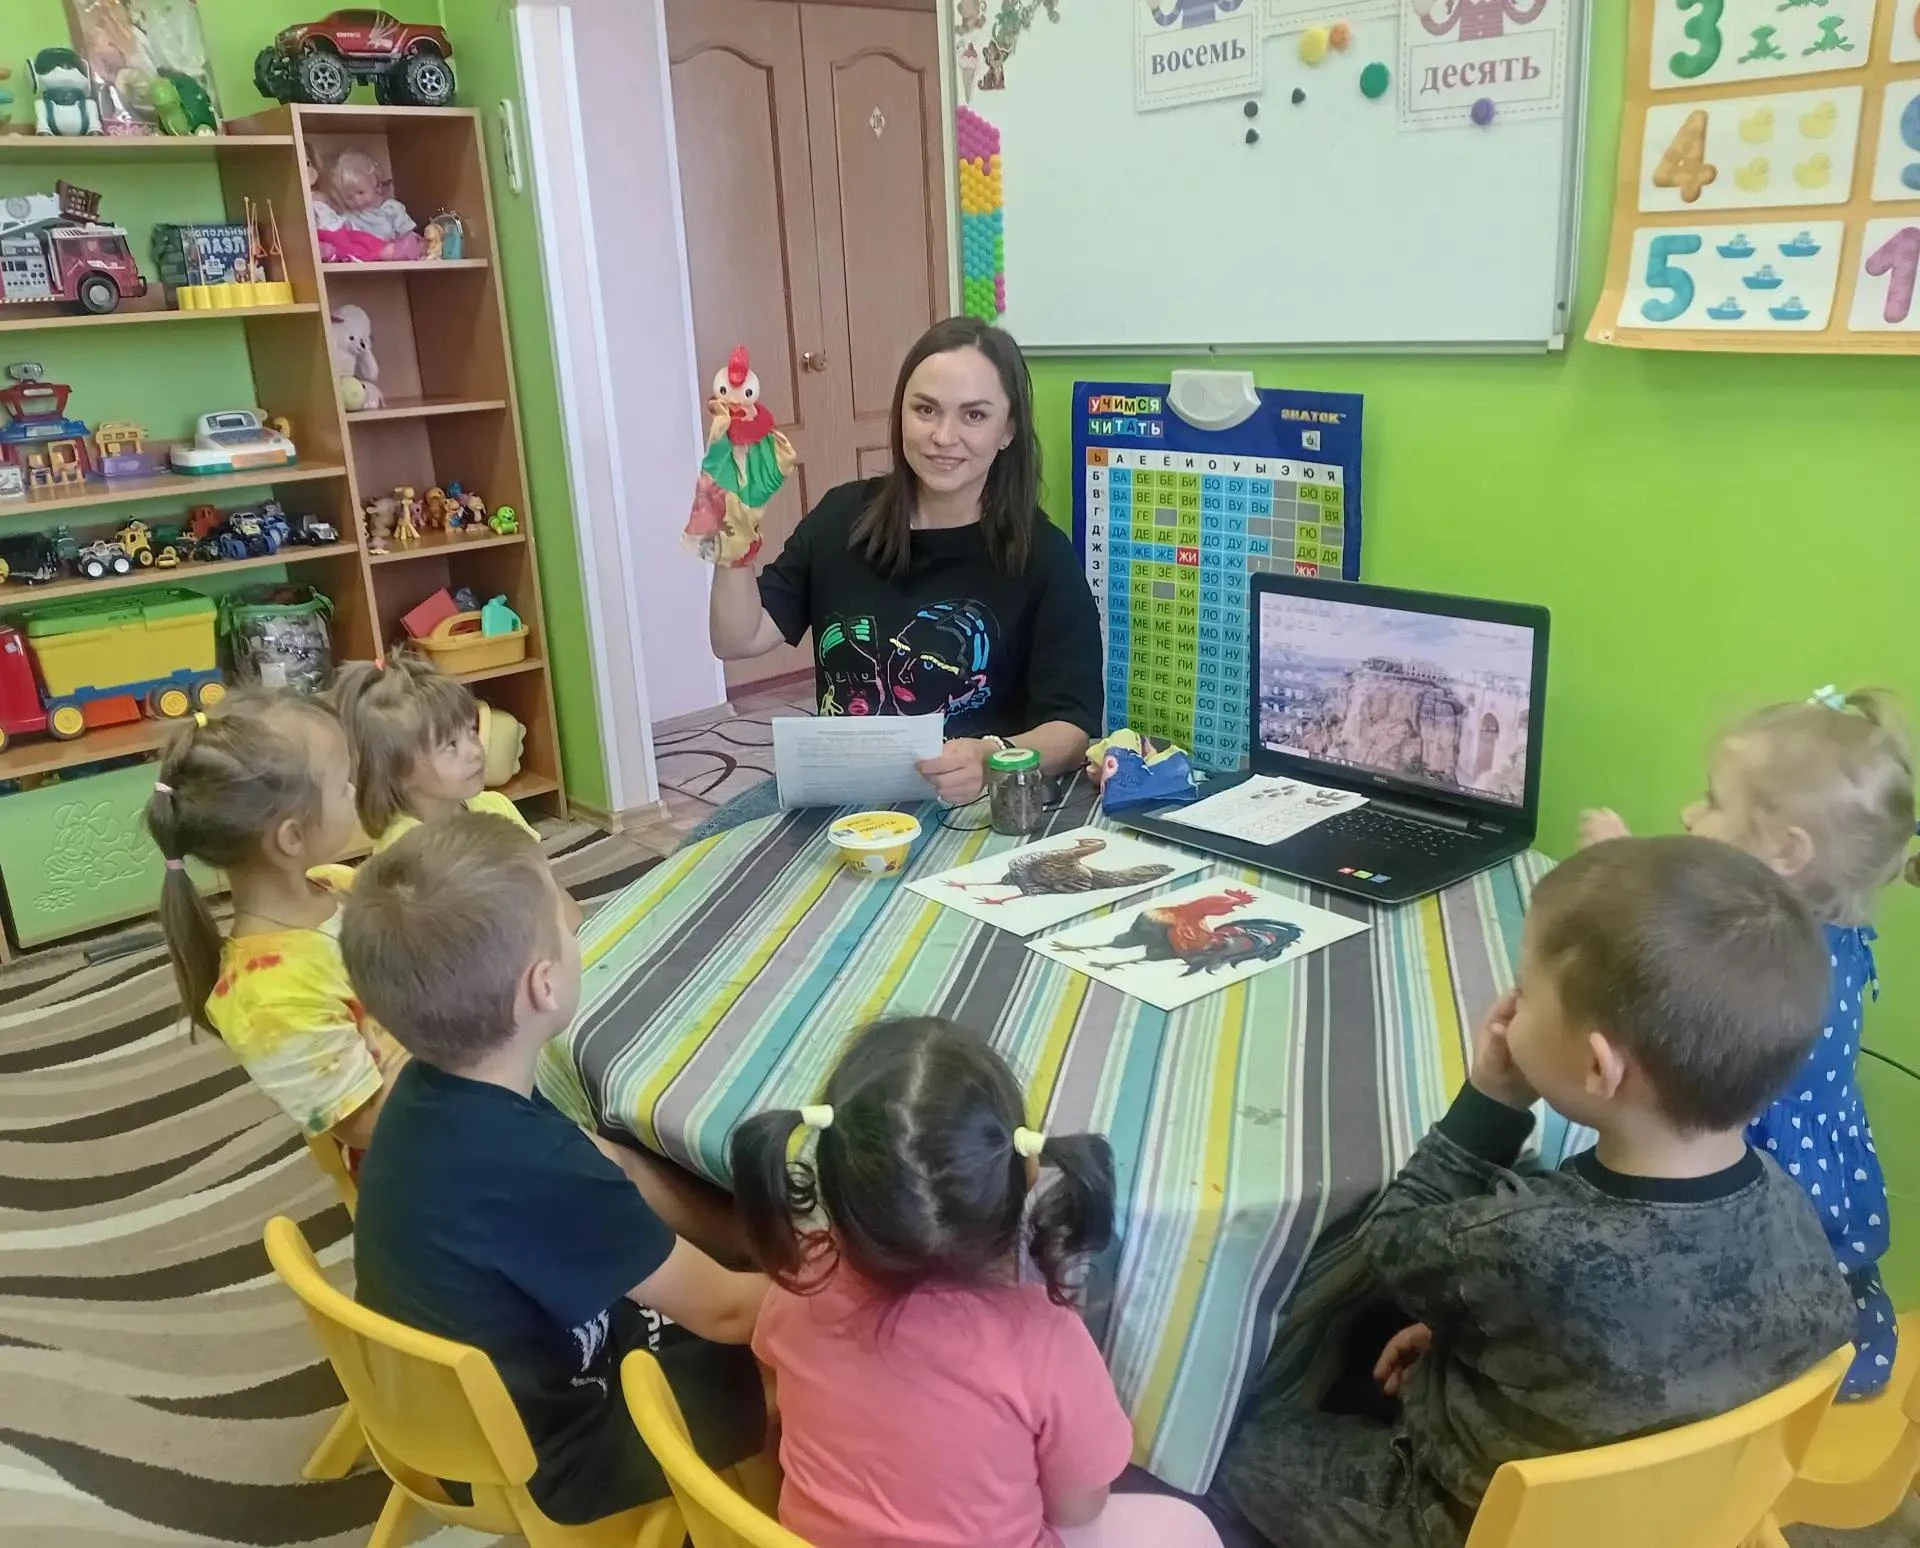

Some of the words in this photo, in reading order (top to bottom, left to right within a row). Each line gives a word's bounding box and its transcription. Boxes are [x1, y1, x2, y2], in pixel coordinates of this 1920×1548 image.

[1151, 38, 1246, 75] восемь
[1420, 56, 1540, 95] десять
[1653, 109, 1718, 203] 4
[197, 237, 246, 254] ПАЗЛ
[1641, 234, 1702, 321] 5
[1090, 397, 1160, 413] УЧИМСЯ
[1090, 419, 1161, 435] ЧИТАТЬ
[1113, 472, 1128, 483] БА
[1136, 474, 1150, 484] БЕ
[1182, 477, 1196, 488] БИ
[1204, 479, 1220, 489] БО
[1229, 481, 1243, 492] БУ
[1252, 482, 1269, 494] БЫ
[1300, 488, 1318, 499] БЮ
[1325, 491, 1338, 501] БЯ
[1113, 491, 1128, 501] ВА
[1136, 492, 1150, 503] ВЕ
[1182, 496, 1196, 506] ВИ
[1204, 498, 1220, 509] ВО
[1229, 500, 1243, 512] ВУ
[1252, 502, 1268, 514] ВЫ
[1325, 511, 1339, 522] ВЯ
[1114, 508, 1126, 518] ГА
[1137, 510, 1149, 521] ГЕ
[1182, 515, 1196, 525] ГИ
[1205, 517, 1218, 528] ГО
[1229, 519, 1241, 530] ГУ
[1300, 527, 1316, 539] ГЮ
[1112, 527, 1126, 538] ДА
[1134, 529, 1149, 540] ДЕ
[1180, 533, 1196, 544] ДИ
[1203, 536, 1220, 548] ДО
[1227, 538, 1242, 550] ДУ
[1250, 540, 1268, 552] ДЫ
[1298, 546, 1317, 559] ДЮ
[1321, 550, 1338, 563] ДЯ
[1135, 546, 1150, 557] ЖЕ
[1179, 550, 1196, 562] ЖИ
[1201, 555, 1220, 565] ЖО
[1226, 557, 1242, 569] ЖУ
[1112, 562, 1126, 572] ЗА
[1135, 565, 1149, 576] ЗЕ
[1180, 570, 1195, 581] ЗИ
[1203, 573, 1219, 584] ЗО
[1227, 576, 1241, 587] ЗУ
[1112, 580, 1125, 590] КА
[1134, 583, 1149, 594] КЕ
[1180, 588, 1195, 599] КИ
[1203, 592, 1218, 602] КО
[1227, 595, 1240, 605] КУ
[1134, 600, 1149, 609] ЛЕ
[1180, 606, 1195, 617] ЛИ
[1202, 609, 1218, 620] ЛО
[1226, 612, 1240, 623] ЛУ
[1112, 615, 1127, 626] МА
[1133, 618, 1149, 629] МЕ
[1178, 623, 1195, 635] МИ
[1200, 627, 1218, 639] МО
[1225, 631, 1241, 642] МУ
[1112, 632, 1126, 642] НА
[1134, 636, 1148, 646] НЕ
[1178, 641, 1193, 652] НИ
[1201, 646, 1217, 656] НО
[1225, 649, 1239, 659] НУ
[1133, 652, 1147, 663] ПЕ
[1178, 659, 1193, 670] ПИ
[1201, 664, 1216, 674] ПО
[1225, 666, 1239, 678] ПУ
[1111, 666, 1124, 676] РА
[1133, 669, 1146, 680] РЕ
[1177, 677, 1192, 688] РИ
[1200, 681, 1215, 692] РО
[1224, 685, 1238, 696] РУ
[1110, 683, 1124, 694] СА
[1131, 687, 1145, 698] СЕ
[1175, 694, 1191, 705] СИ
[1198, 698, 1215, 710] СО
[1223, 702, 1238, 713] СУ
[1175, 711, 1189, 723] ТИ
[1199, 716, 1213, 727] ТО
[1223, 720, 1236, 731] ТУ
[1173, 729, 1190, 741] ФИ
[1195, 734, 1214, 745] ФО
[1220, 738, 1237, 749] ФУ
[1220, 756, 1234, 766] ХУ
